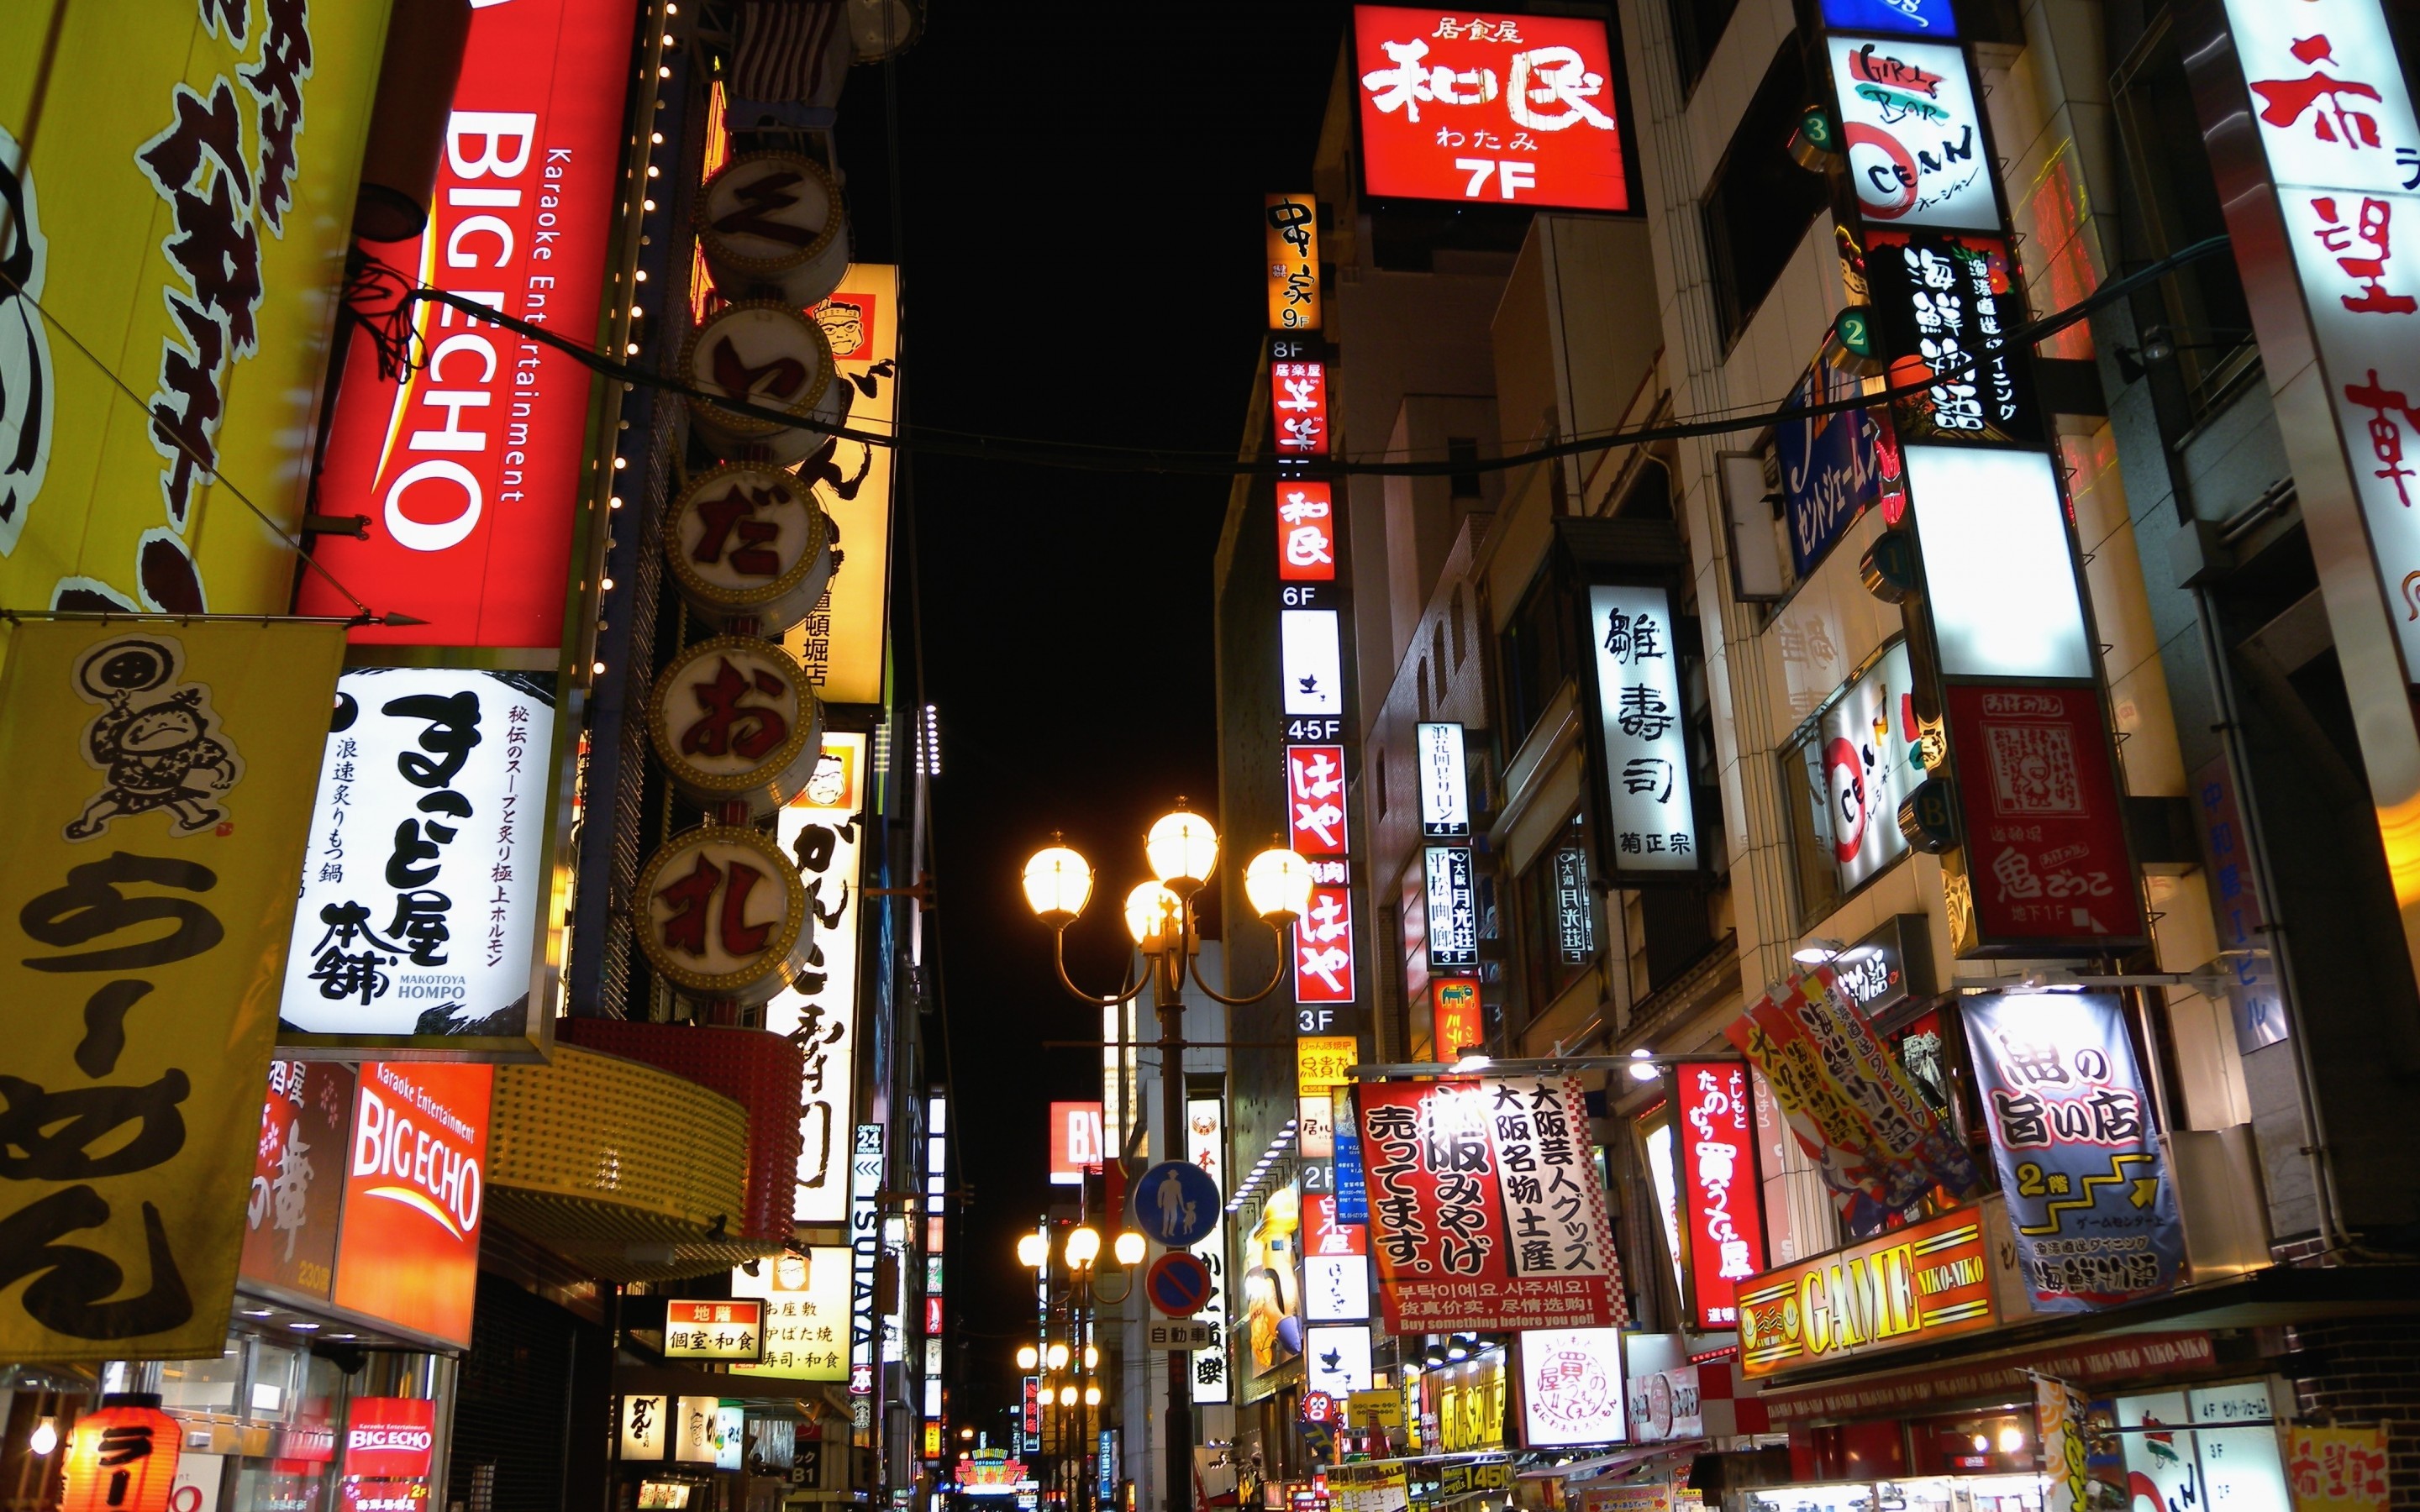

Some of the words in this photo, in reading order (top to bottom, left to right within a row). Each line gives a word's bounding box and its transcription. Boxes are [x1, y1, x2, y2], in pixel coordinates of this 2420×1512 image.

[1432, 17, 1523, 44] 居食屋
[1362, 39, 1615, 132] 和民
[1859, 44, 1946, 99] GIRLS
[1863, 88, 1948, 126] BAR
[1437, 126, 1538, 151] わたみ
[1809, 118, 1826, 141] 3
[445, 111, 538, 270] BIG
[1455, 159, 1535, 198] 7F
[533, 148, 572, 260] Karaoke
[1281, 308, 1310, 328] 9F
[1846, 320, 1863, 345] 2
[1274, 341, 1303, 357] 8F
[502, 276, 555, 503] Entrtainment
[384, 291, 501, 551] ECHO
[1277, 378, 1322, 451] 笑笑
[1280, 491, 1332, 566] 和民
[1283, 586, 1316, 606] 6F
[318, 738, 358, 883] 浪速炙りもつ鍋
[1292, 753, 1343, 847] はや
[381, 691, 481, 966] まこと屋
[1619, 832, 1691, 854] 菊正宗
[1454, 864, 1466, 886] 大阪
[1992, 846, 2113, 903] 鬼ごっこ
[1452, 889, 1474, 948] 月光荘
[1299, 895, 1349, 993] はや
[1442, 952, 1468, 963] 3F
[398, 985, 466, 1000] HOMPO
[399, 975, 466, 985] MAKOTOYA
[1299, 1011, 1334, 1032] 3F
[377, 1062, 414, 1103] Karaoke
[416, 1086, 476, 1144] Entertainment
[1729, 1069, 1746, 1129] よしもと
[1992, 1090, 2141, 1144] 旨い店
[857, 1132, 881, 1147] 24
[353, 1087, 413, 1178] BIG
[413, 1130, 481, 1232] ECHO
[1493, 1084, 1557, 1272] 大阪名物土産
[1528, 1083, 1596, 1271] 大阪芸人グッズ
[1367, 1106, 1432, 1272] 売ってます。
[1422, 1089, 1492, 1274] 阪みやげ
[2017, 1163, 2070, 1197] 2階
[1918, 1255, 1985, 1297] NIKO-NIKO
[2035, 1256, 2158, 1294] 海鮮物語
[693, 1305, 731, 1322] 地階
[765, 1300, 817, 1316] お座敷
[1801, 1243, 1922, 1354] GAME
[1151, 1326, 1207, 1344] 自動車
[1400, 1318, 1425, 1331] Buy
[1428, 1316, 1498, 1330] something
[1500, 1315, 1543, 1327] before
[1544, 1315, 1567, 1327] you
[1570, 1314, 1595, 1325] go!!
[851, 1368, 872, 1391] 本
[349, 1431, 387, 1448] BIG
[388, 1431, 431, 1449] ECHO
[2210, 1443, 2223, 1458] 3F
[410, 1483, 427, 1498] 2F
[792, 1470, 813, 1483] B1
